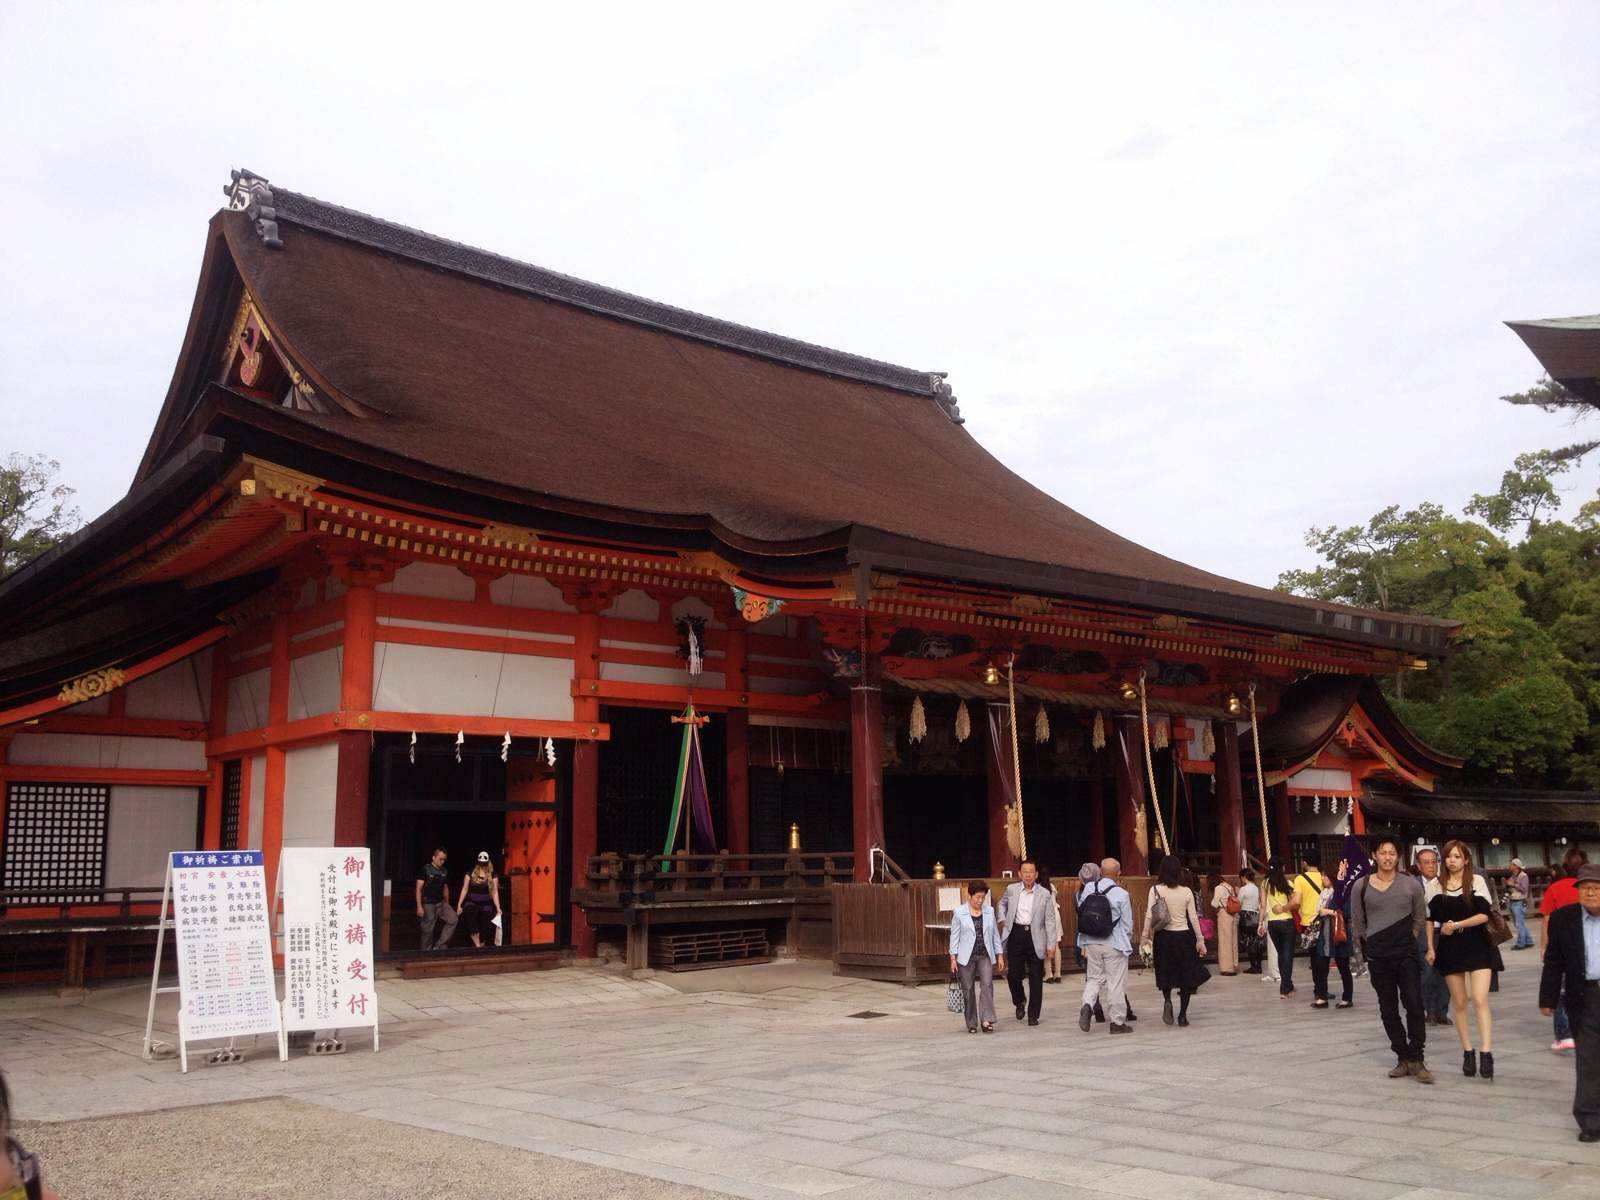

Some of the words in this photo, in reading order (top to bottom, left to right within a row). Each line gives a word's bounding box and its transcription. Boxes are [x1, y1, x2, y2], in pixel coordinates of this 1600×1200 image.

[182, 854, 254, 866] 御祈祷ご案内
[180, 894, 216, 903] 家内安全
[182, 905, 218, 914] 受験合格
[327, 863, 339, 1010] 受付は御本殿内にございます
[342, 856, 369, 1016] 御祈祷受付
